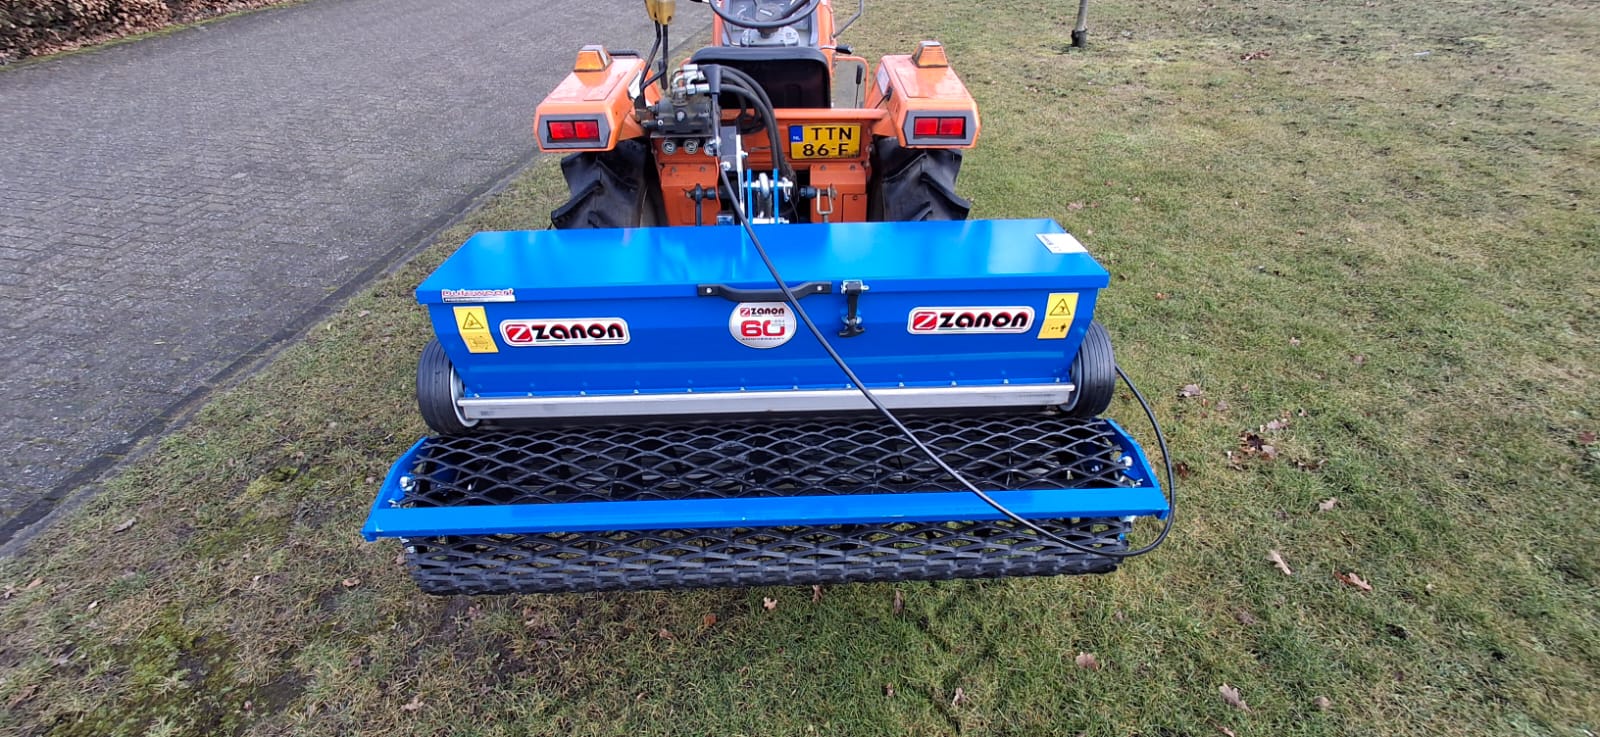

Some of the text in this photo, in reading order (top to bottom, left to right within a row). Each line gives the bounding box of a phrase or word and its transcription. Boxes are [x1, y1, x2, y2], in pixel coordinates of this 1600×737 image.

[811, 127, 852, 140] TTN
[803, 143, 849, 156] 86-F
[741, 319, 785, 337] 60
